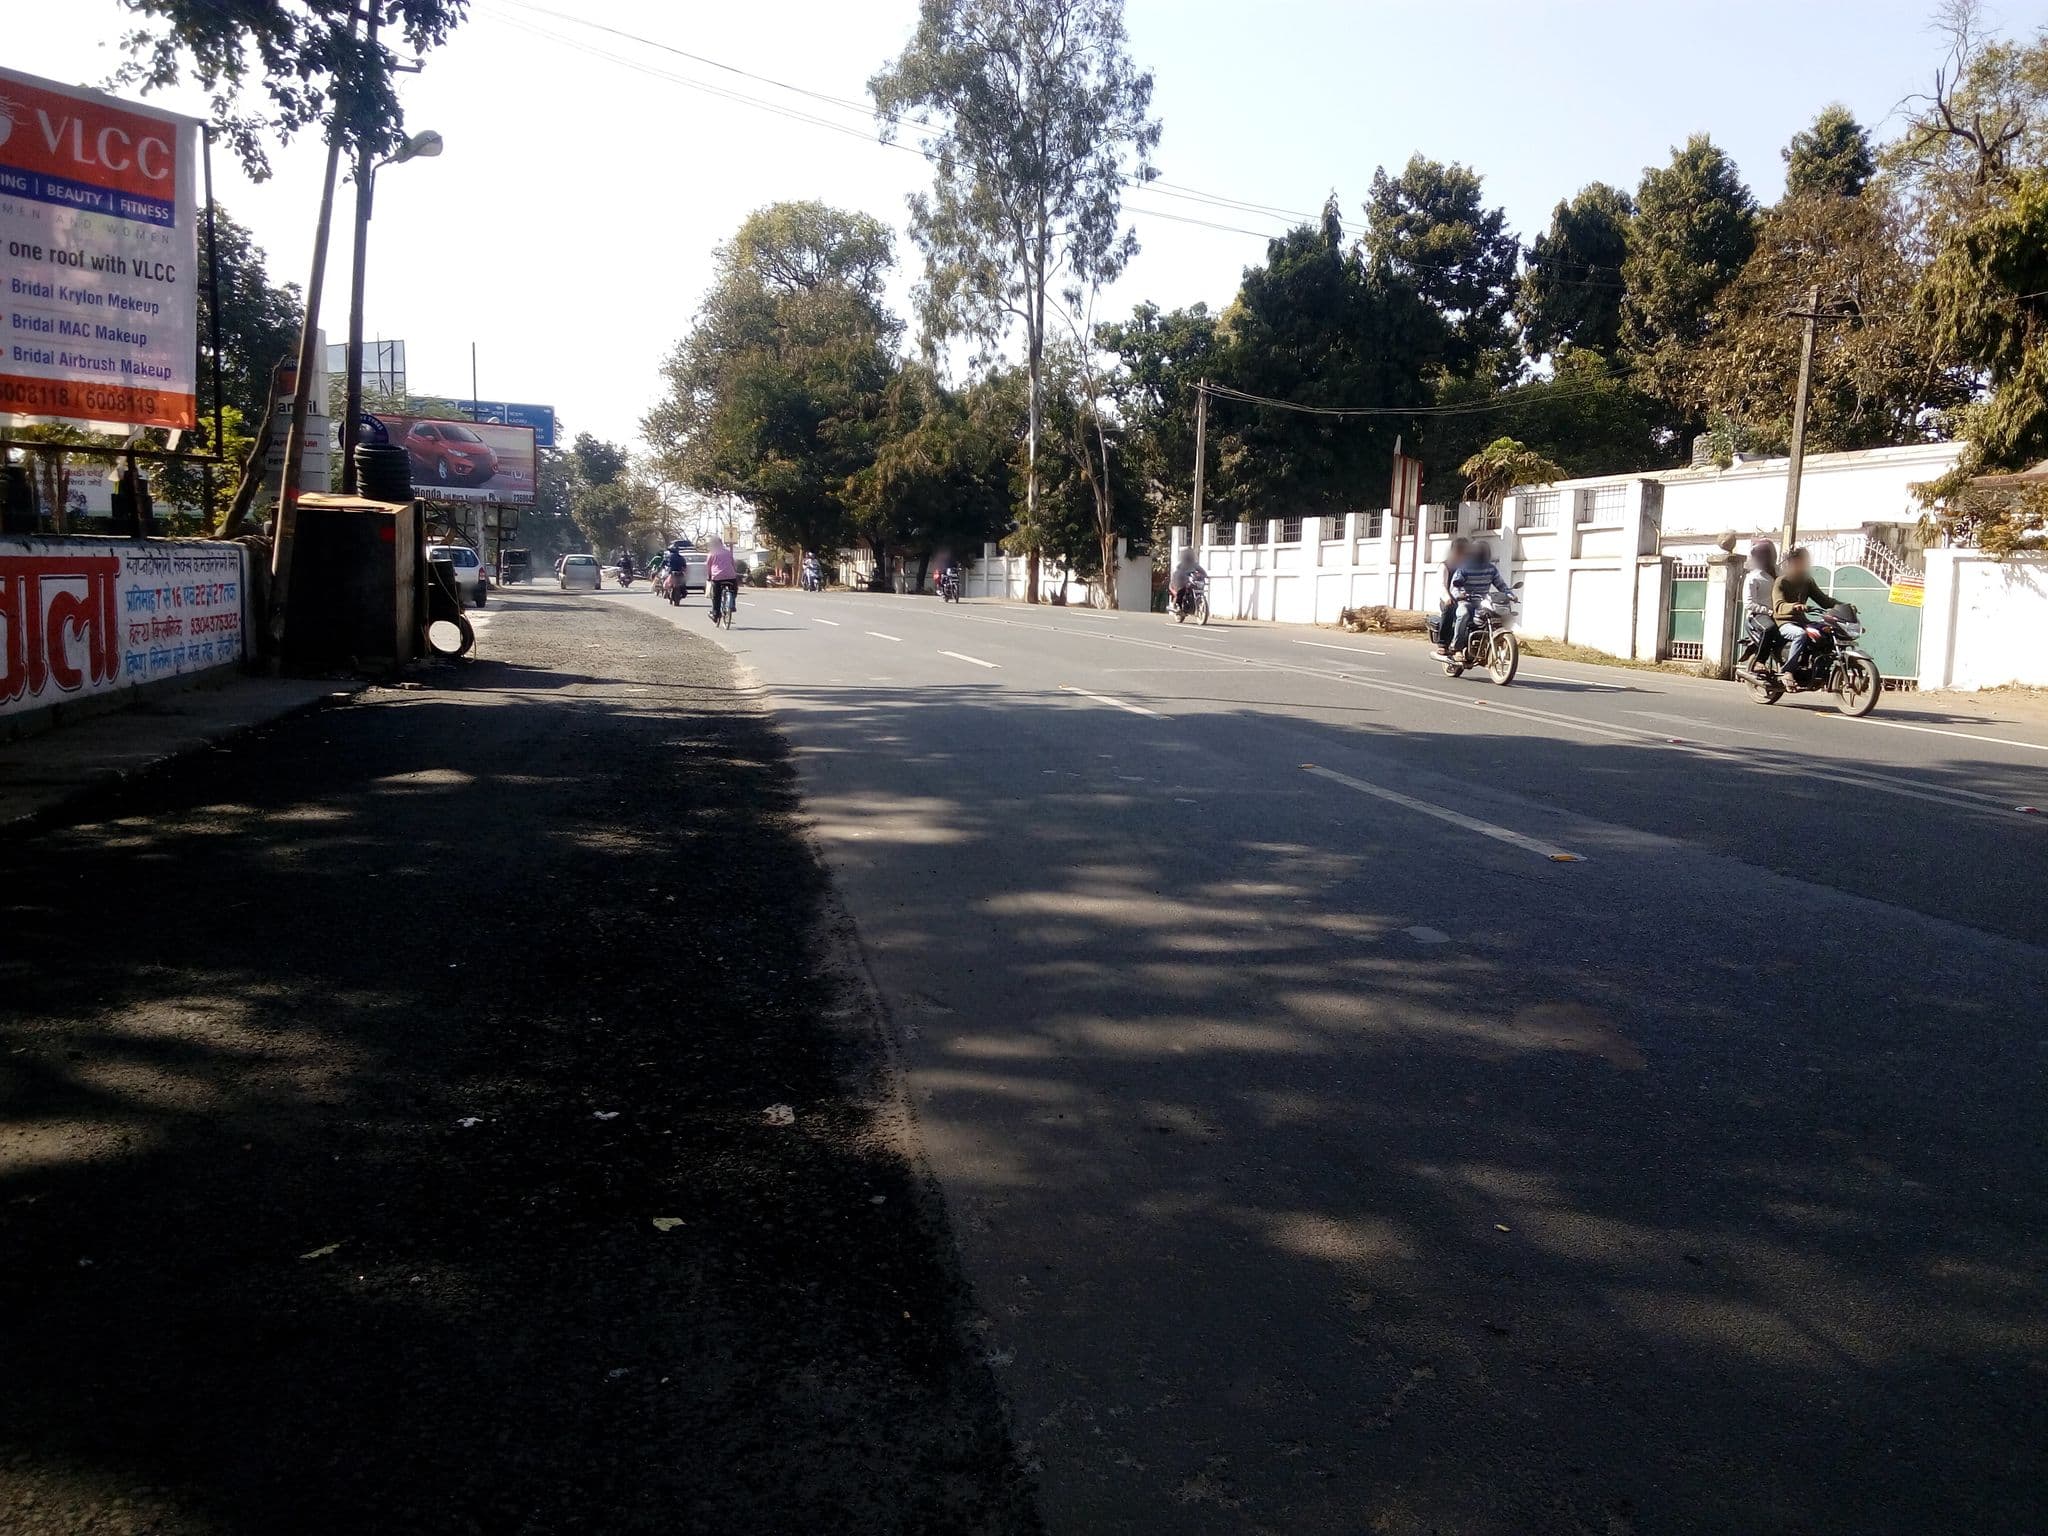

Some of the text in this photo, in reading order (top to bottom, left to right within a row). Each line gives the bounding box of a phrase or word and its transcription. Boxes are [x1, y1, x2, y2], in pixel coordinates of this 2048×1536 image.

[37, 108, 169, 180] VLCC
[47, 183, 102, 205] BEAUTY
[121, 199, 169, 220] FITNESS
[10, 241, 176, 283] one roof with VLCC
[12, 278, 159, 316] Bridal Krylon Mekeup
[13, 314, 147, 347] Bridal MAC Makeup
[13, 347, 172, 381] Bridal Airbrush Makeup
